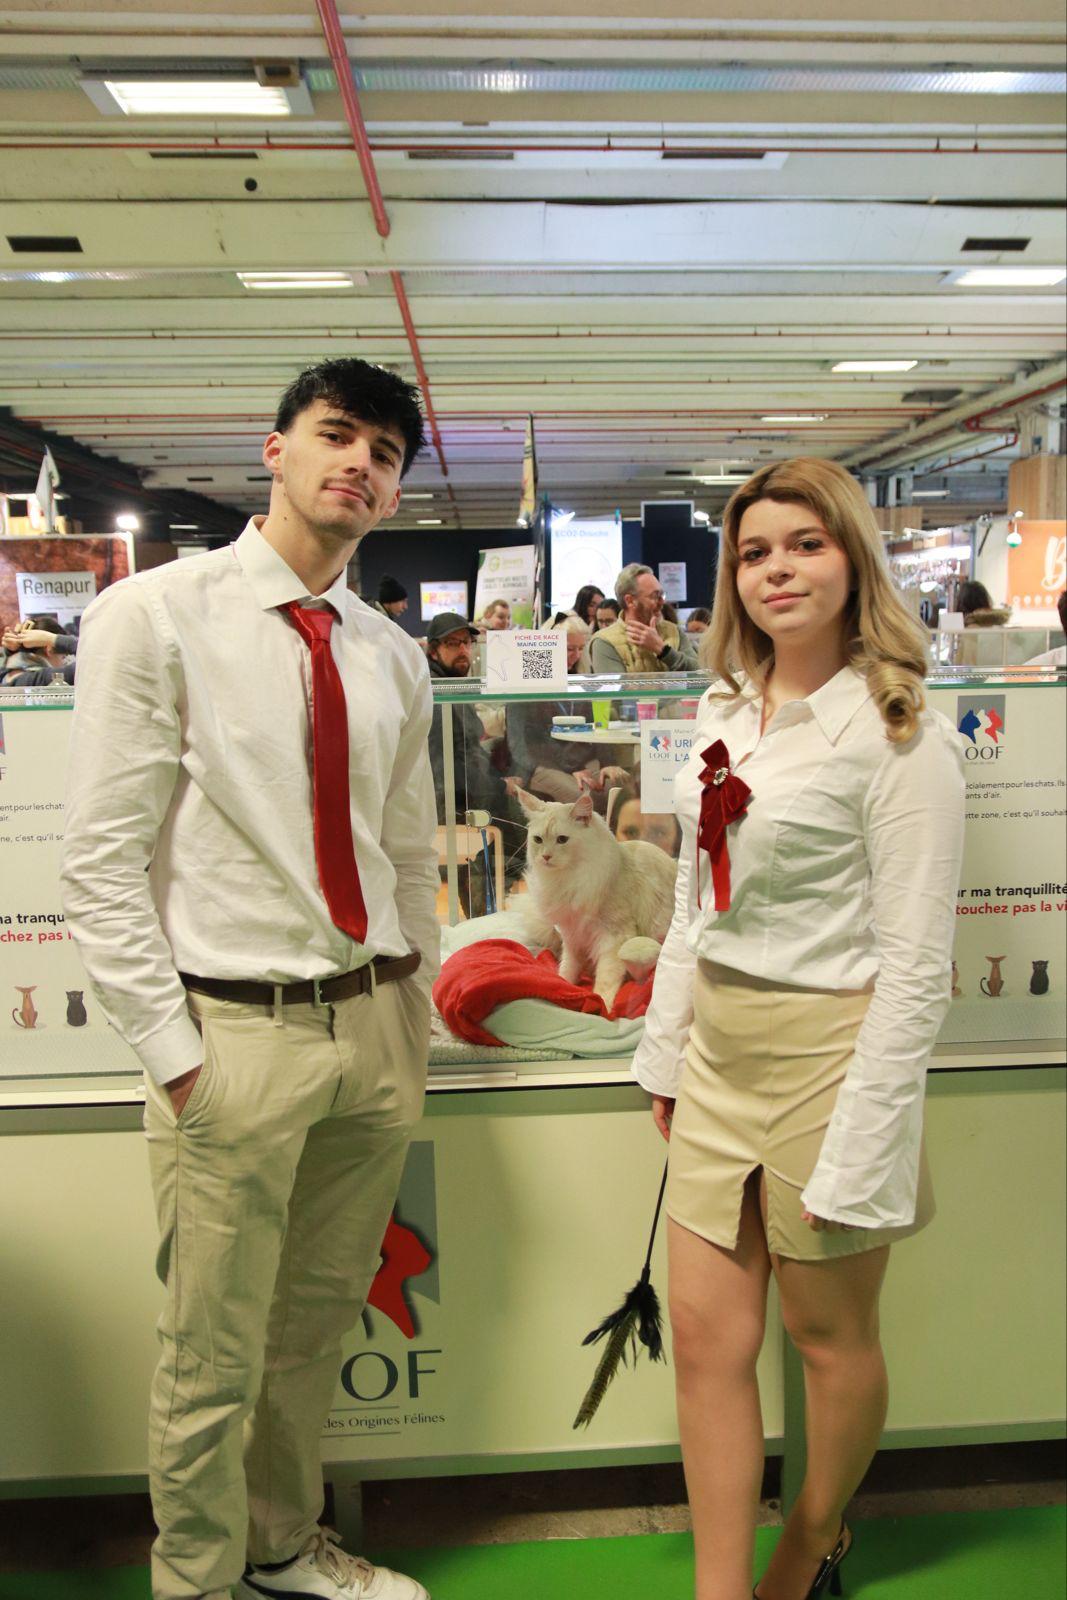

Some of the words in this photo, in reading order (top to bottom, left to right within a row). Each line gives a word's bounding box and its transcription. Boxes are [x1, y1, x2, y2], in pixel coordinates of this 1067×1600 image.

[23, 579, 91, 597] Renapur
[1005, 782, 1024, 791] pour
[1023, 779, 1034, 788] les
[13, 804, 33, 813] pour
[33, 802, 45, 811] les
[1003, 809, 1021, 818] c'est
[15, 833, 34, 842] c'est
[970, 888, 992, 897] ma
[1012, 904, 1037, 917] pas
[1040, 900, 1053, 912] la
[38, 931, 63, 945] pas
[348, 1415, 400, 1429] Origines
[404, 1412, 446, 1425] Félines
